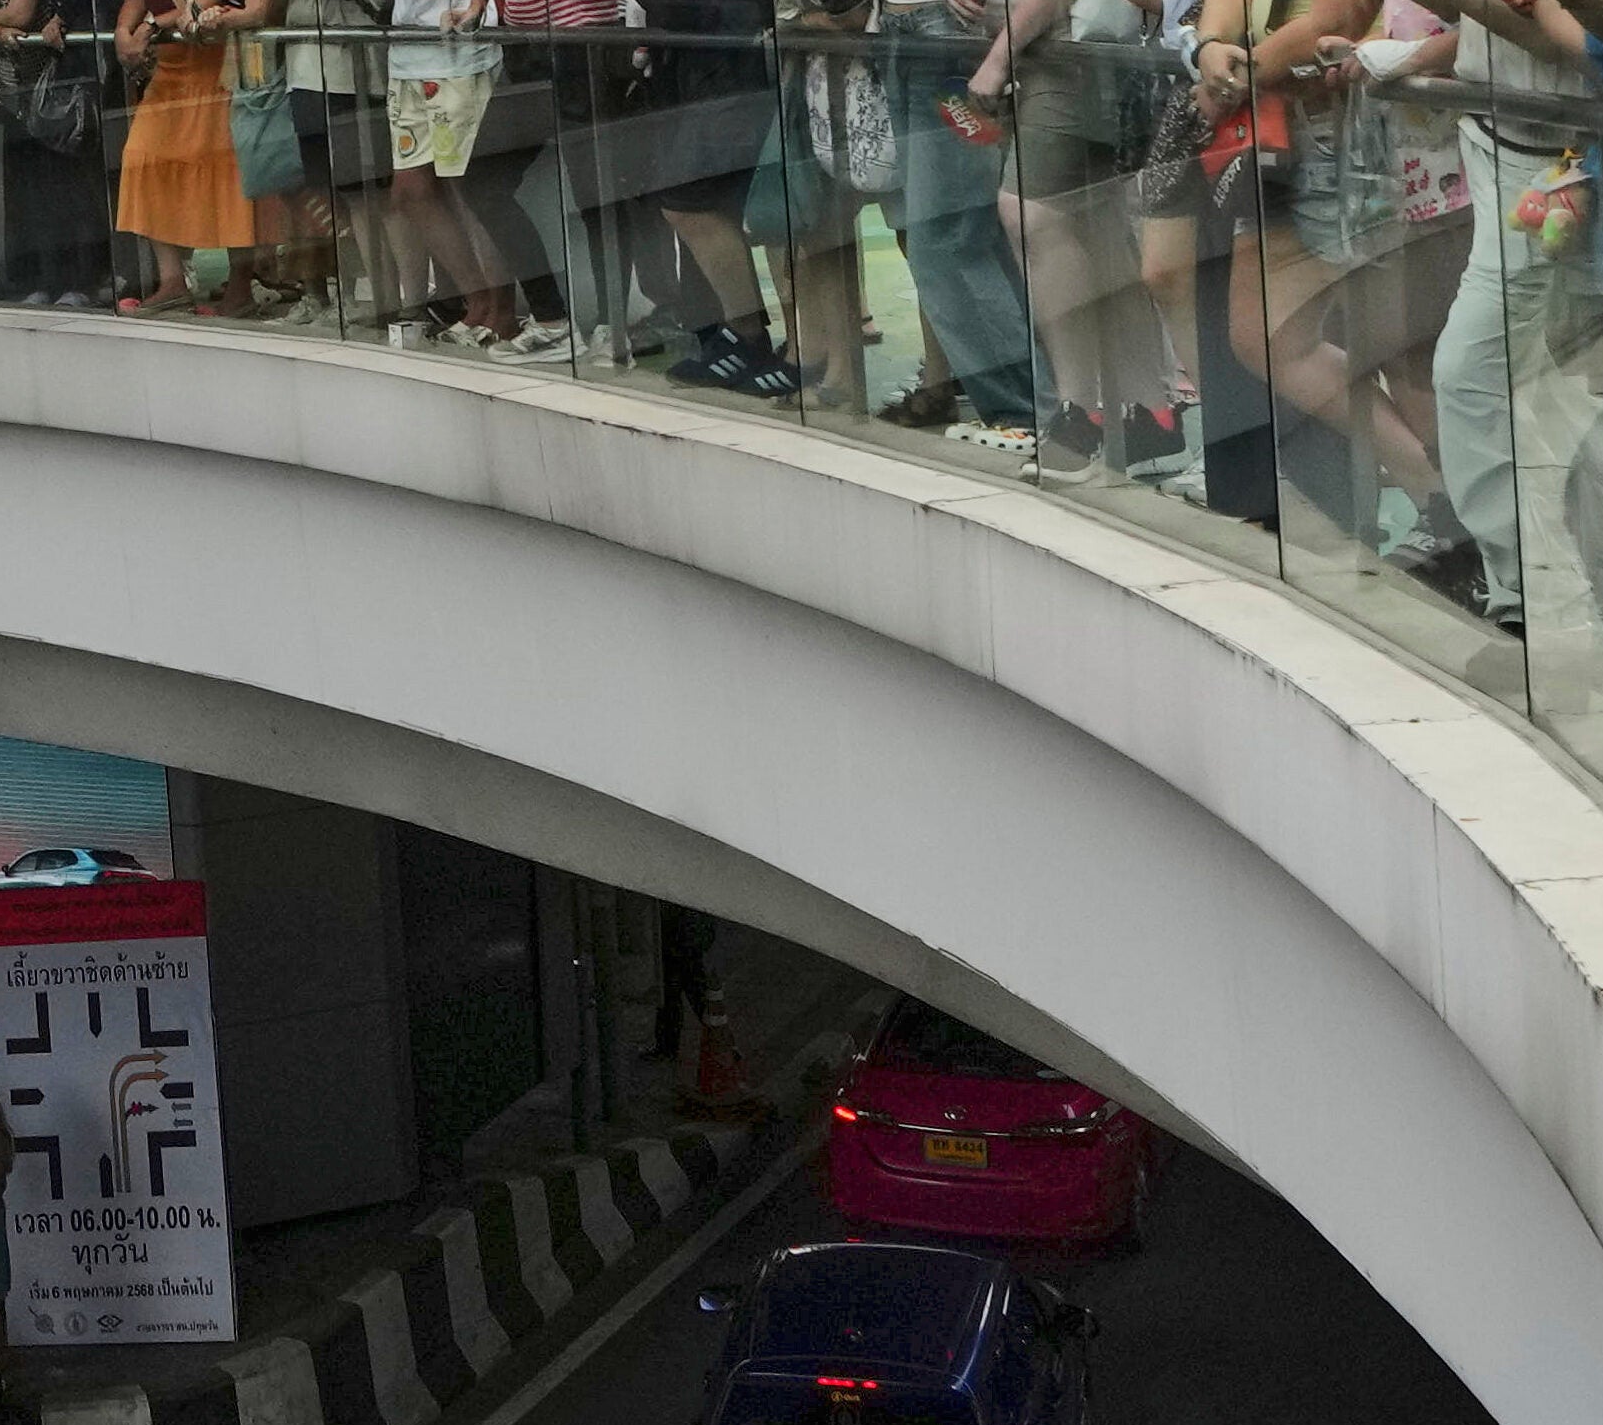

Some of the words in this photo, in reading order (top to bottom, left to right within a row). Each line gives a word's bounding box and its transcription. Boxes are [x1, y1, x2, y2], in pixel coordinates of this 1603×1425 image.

[7, 951, 189, 987] เลี้ยวขวาชิดด้านซ้าย
[14, 1211, 63, 1234] เวลา
[71, 1205, 190, 1232] 06.00-10.00
[197, 1206, 220, 1228] น.
[71, 1233, 148, 1275] ทุกวัน
[29, 1281, 49, 1300] เริ่ม
[52, 1285, 60, 1299] 6
[63, 1284, 123, 1302] พฤษภาคม
[127, 1283, 154, 1297] 2568
[157, 1275, 214, 1297] เป็นต้นไป
